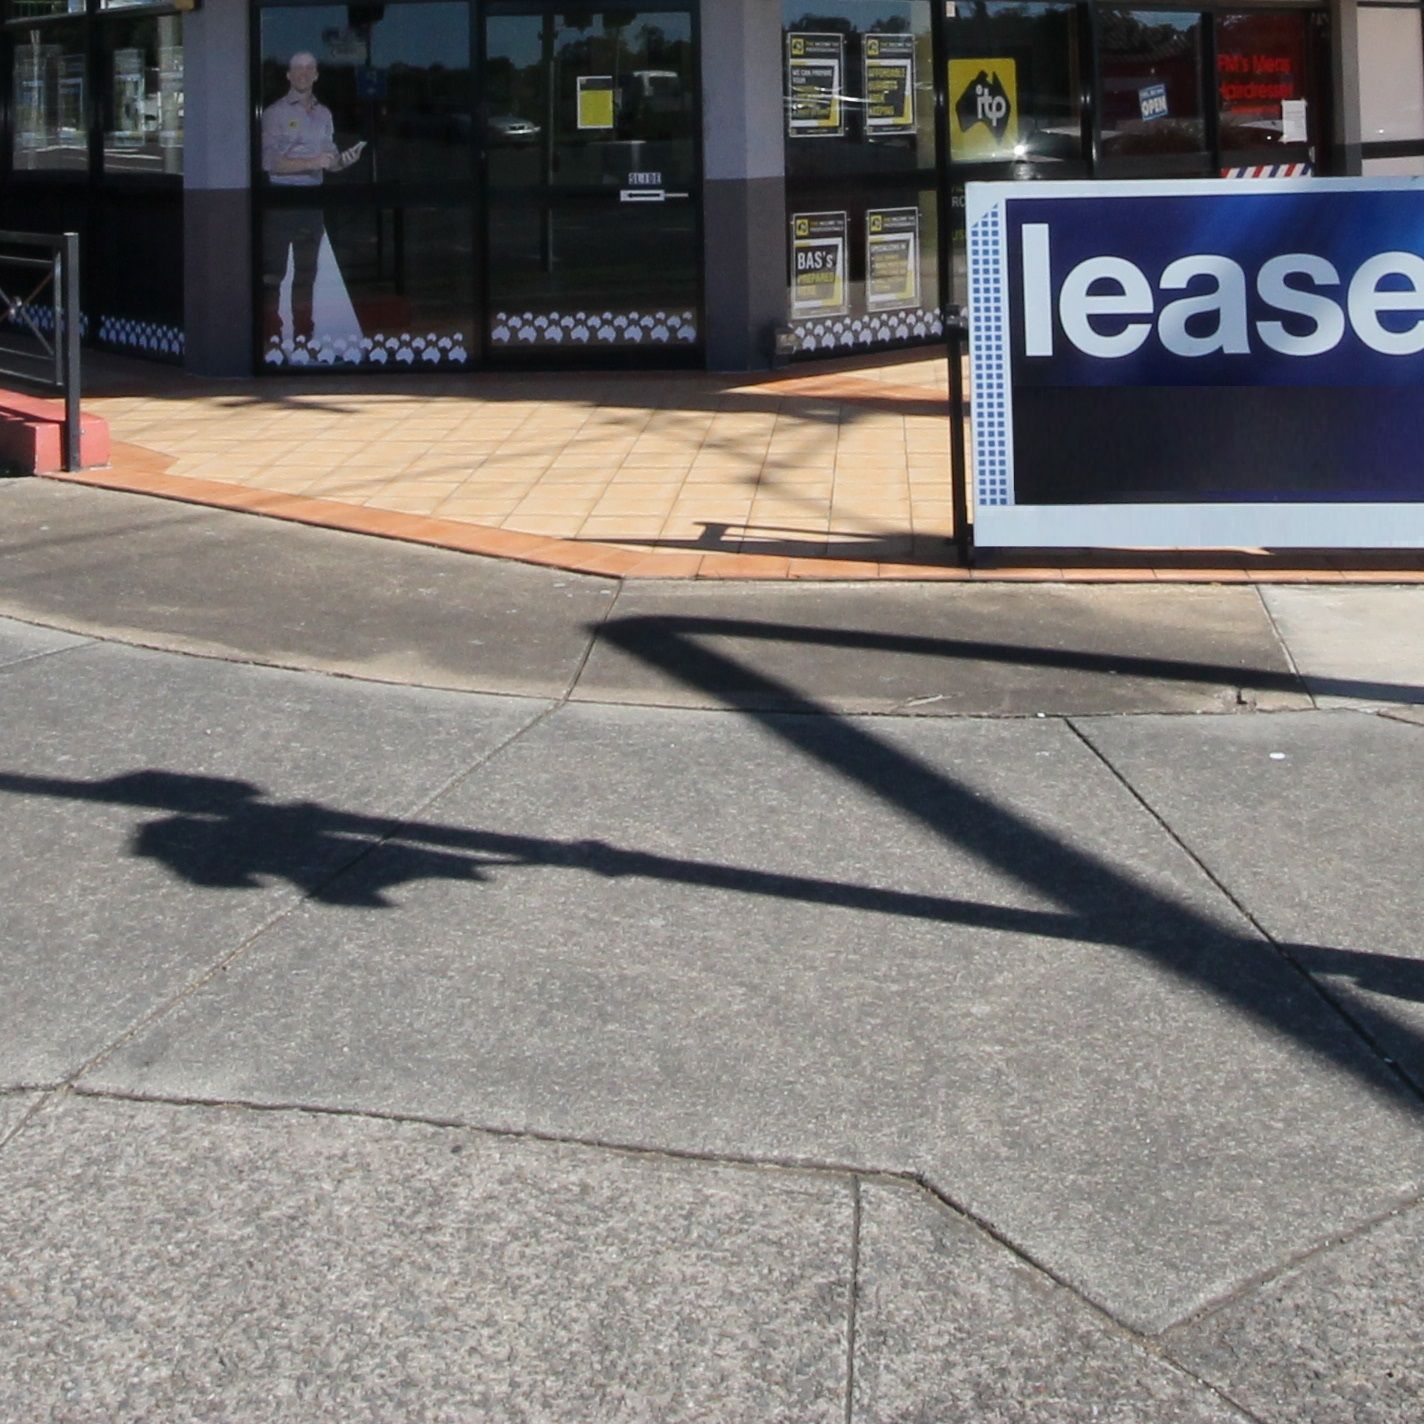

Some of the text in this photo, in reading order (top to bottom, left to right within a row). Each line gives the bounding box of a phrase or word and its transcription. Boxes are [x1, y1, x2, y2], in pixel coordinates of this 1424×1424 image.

[976, 84, 1006, 126] itp
[1141, 95, 1167, 116] OPEN
[629, 172, 661, 185] SLIDE
[797, 250, 834, 270] BAS's
